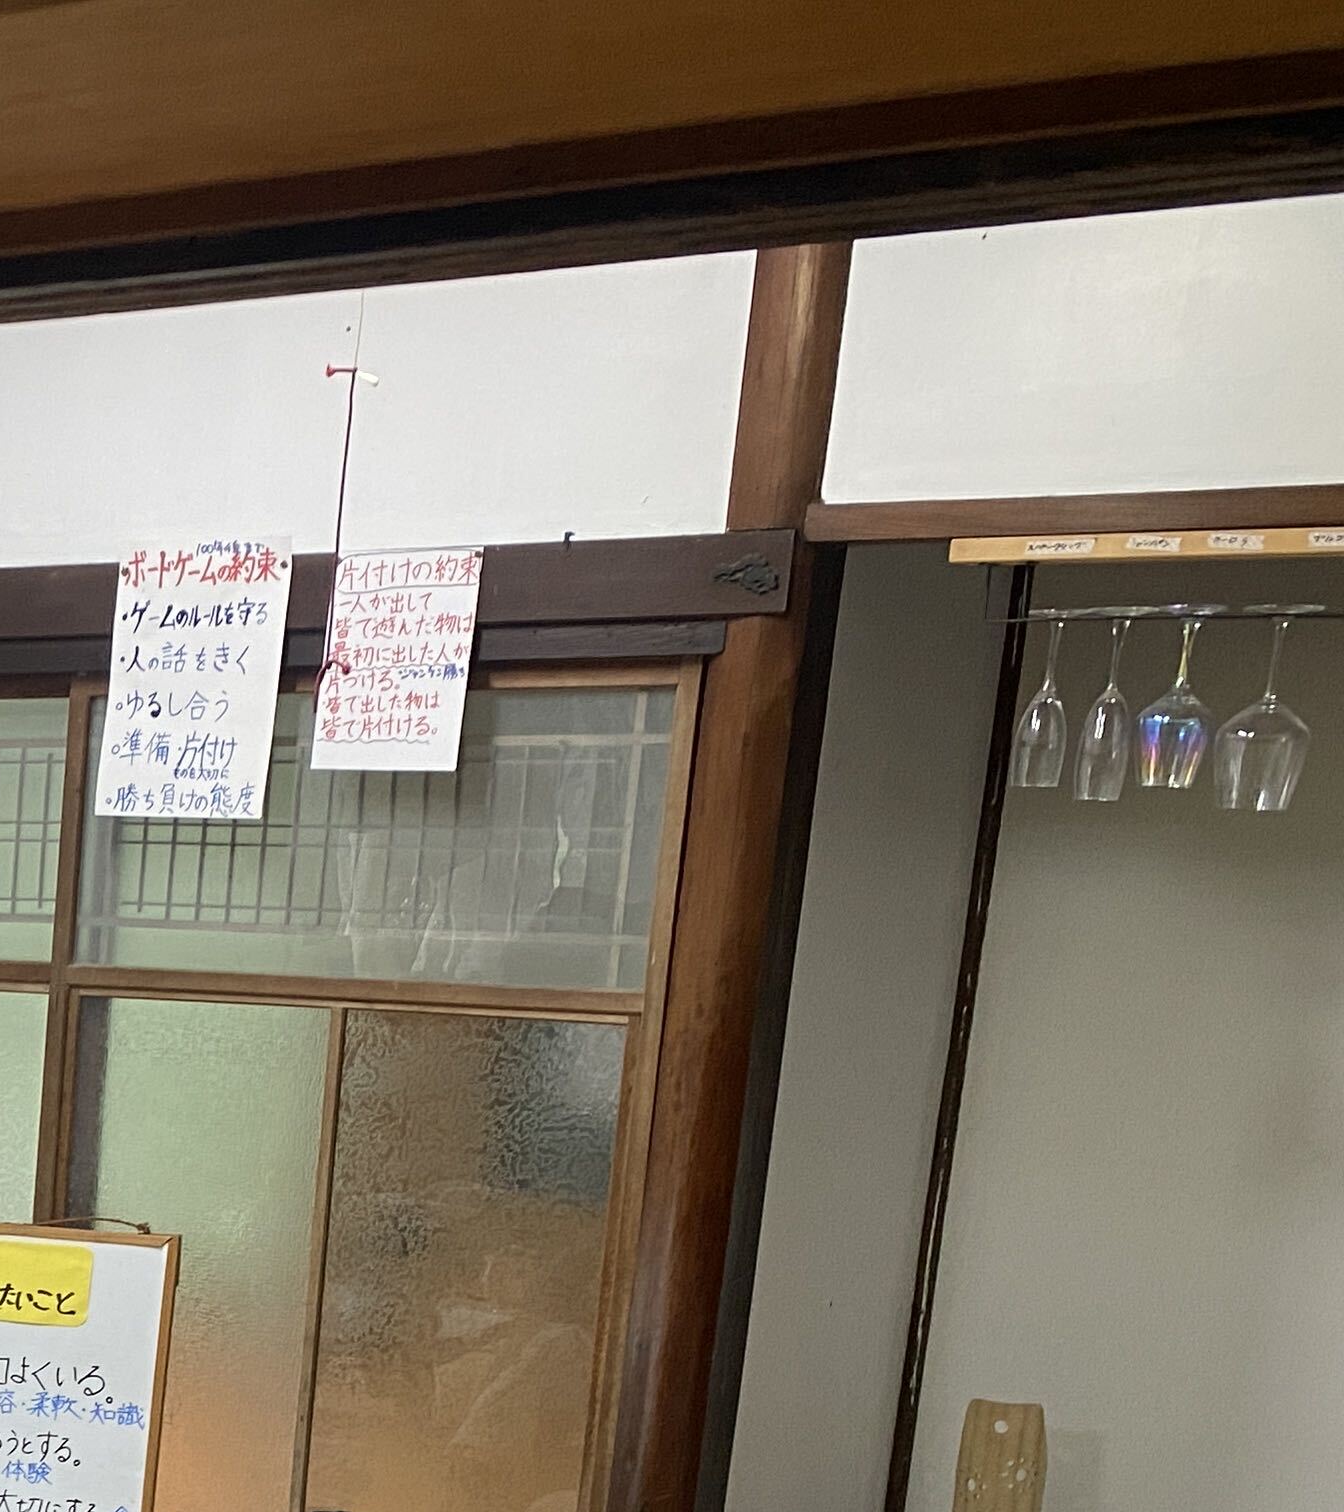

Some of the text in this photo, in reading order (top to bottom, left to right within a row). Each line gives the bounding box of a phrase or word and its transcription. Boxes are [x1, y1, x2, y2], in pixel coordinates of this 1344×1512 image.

[128, 547, 280, 589] ボードゲームの約束
[338, 553, 479, 591] 片付けの約束
[131, 597, 268, 634] ゲームのルールを守る
[335, 612, 473, 639] 皆で遊んだ物は
[126, 641, 250, 674] 人の話をきく
[127, 690, 230, 722] ゆるし合う
[325, 691, 440, 715] 皆で出した物は
[320, 715, 437, 740] 皆で片付ける。
[113, 781, 256, 817] 勝ち負けの態度
